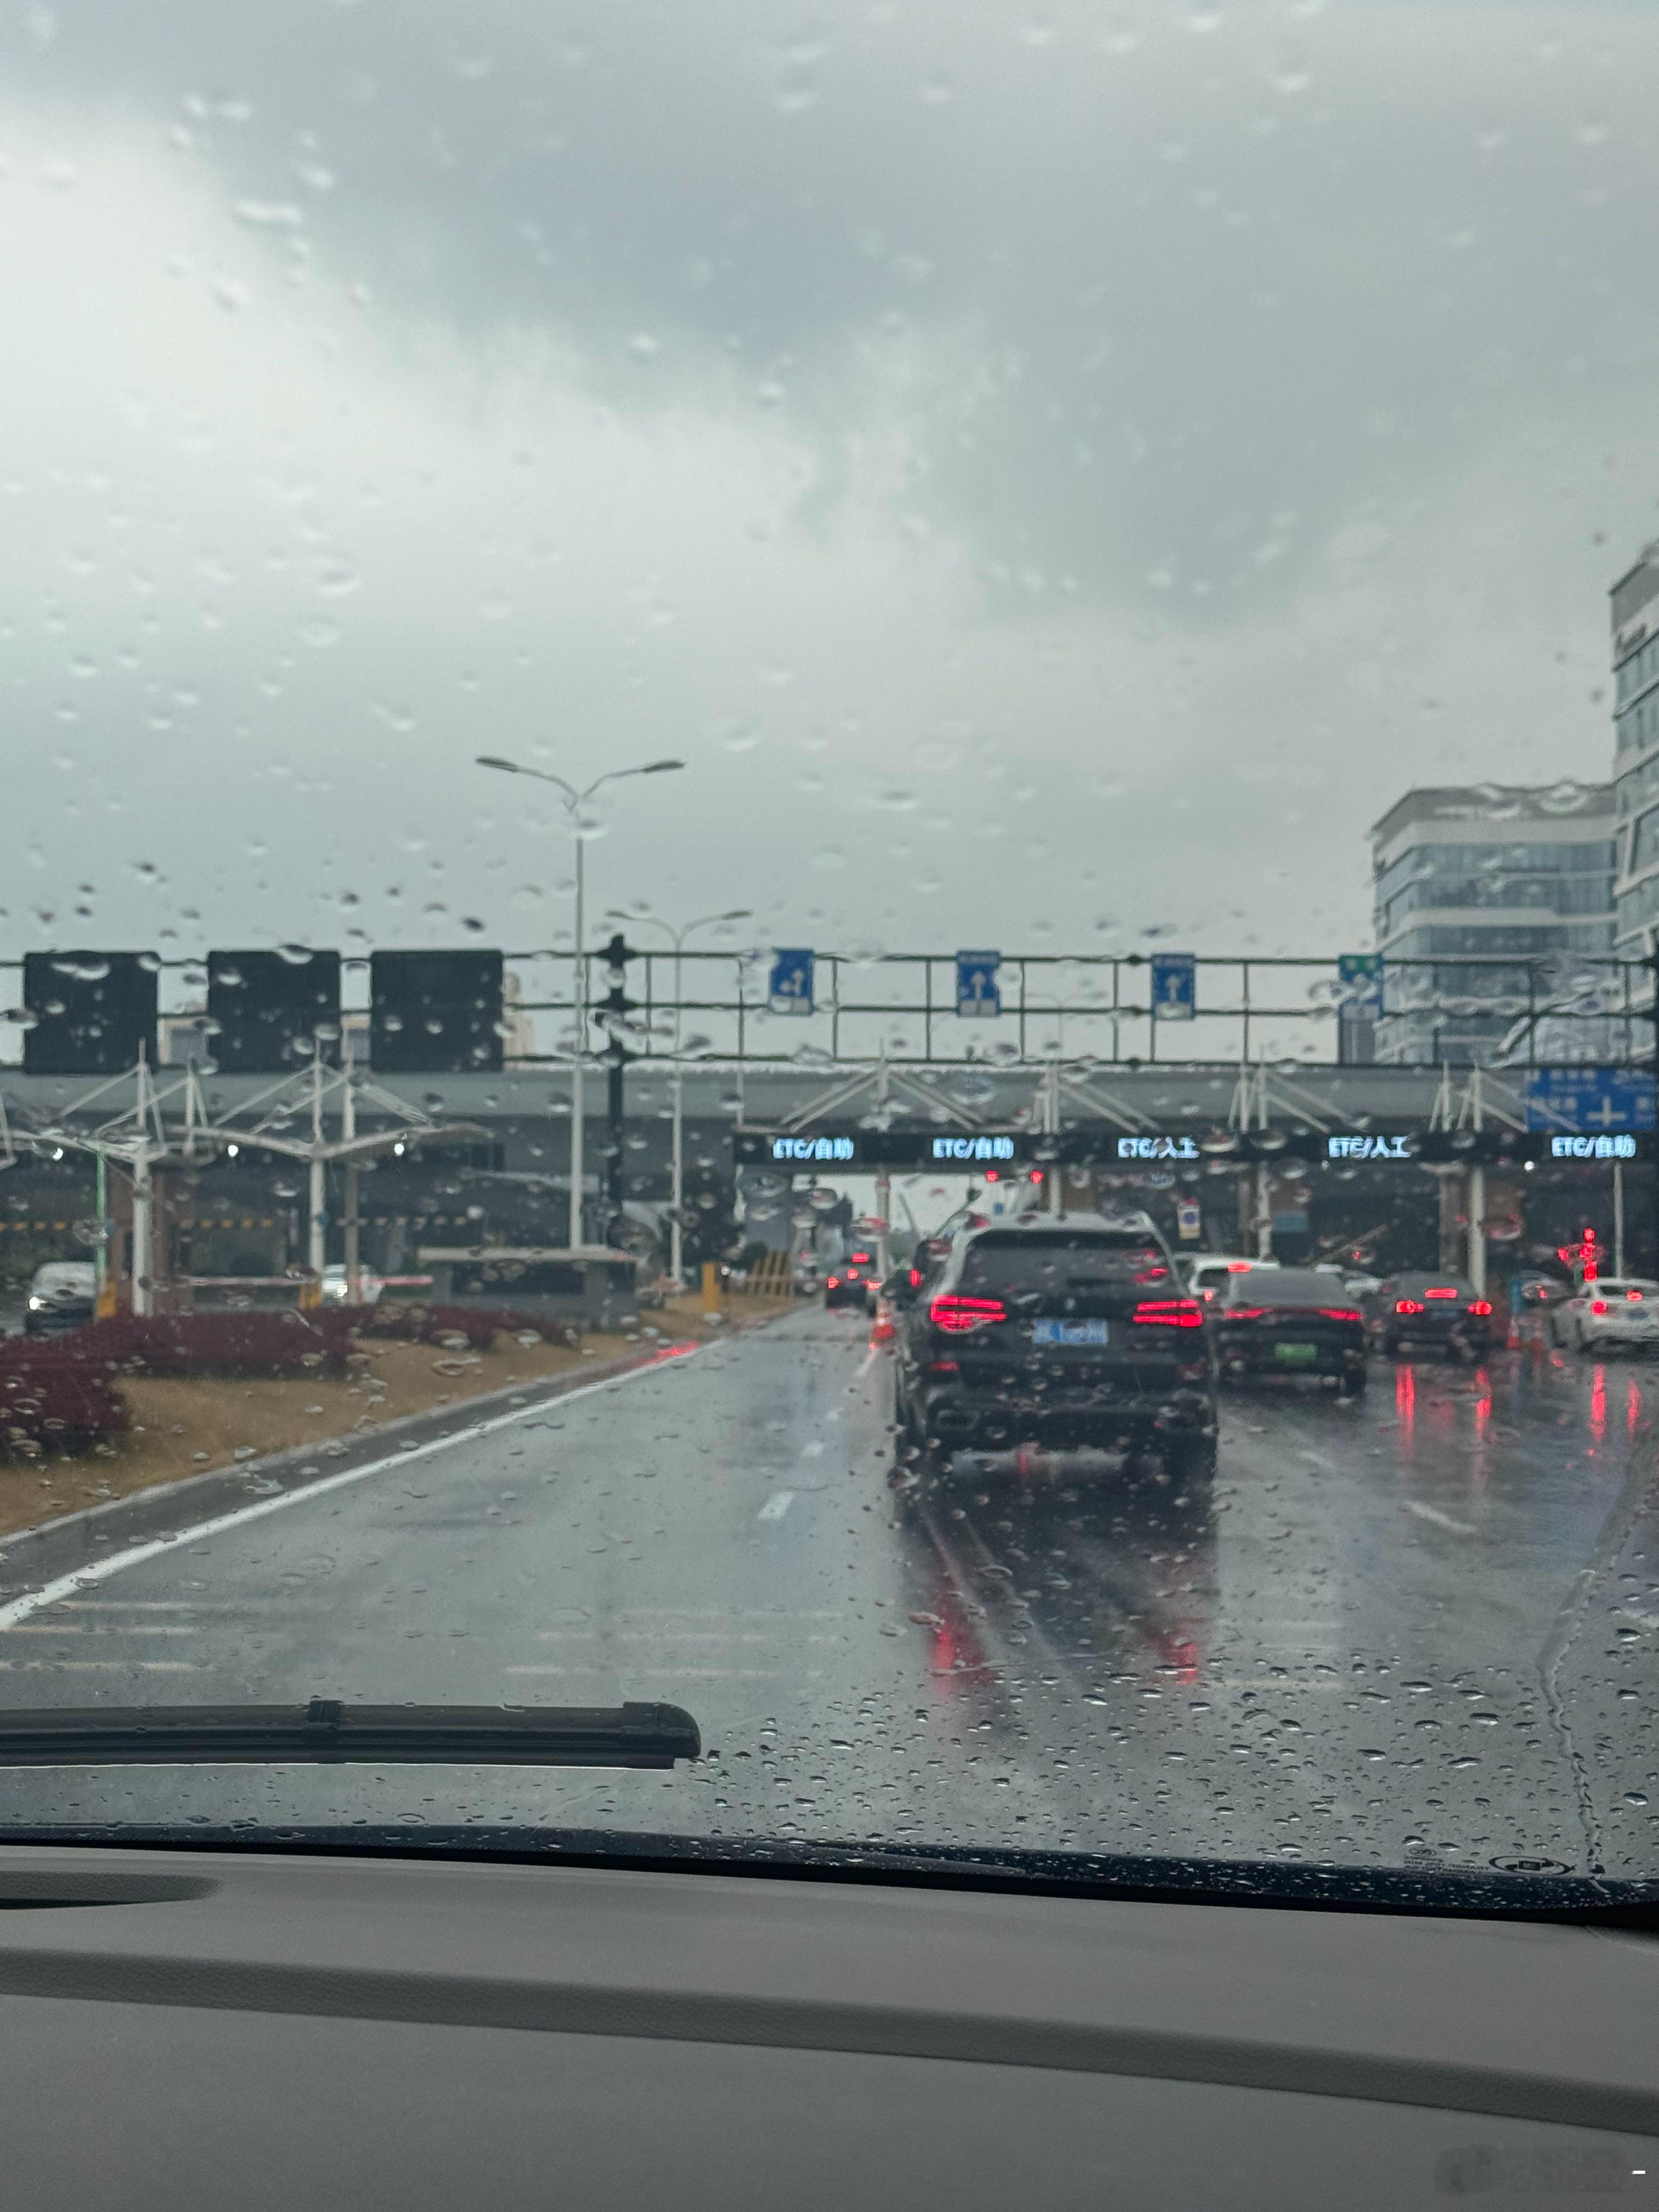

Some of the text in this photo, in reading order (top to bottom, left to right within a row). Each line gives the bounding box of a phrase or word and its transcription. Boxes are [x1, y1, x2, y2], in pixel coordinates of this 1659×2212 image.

[772, 1136, 854, 1160] ETC/自助
[933, 1136, 1014, 1160] ETC/自助
[1328, 1136, 1413, 1159] ETC/人工
[1551, 1134, 1636, 1159] ETC/自助
